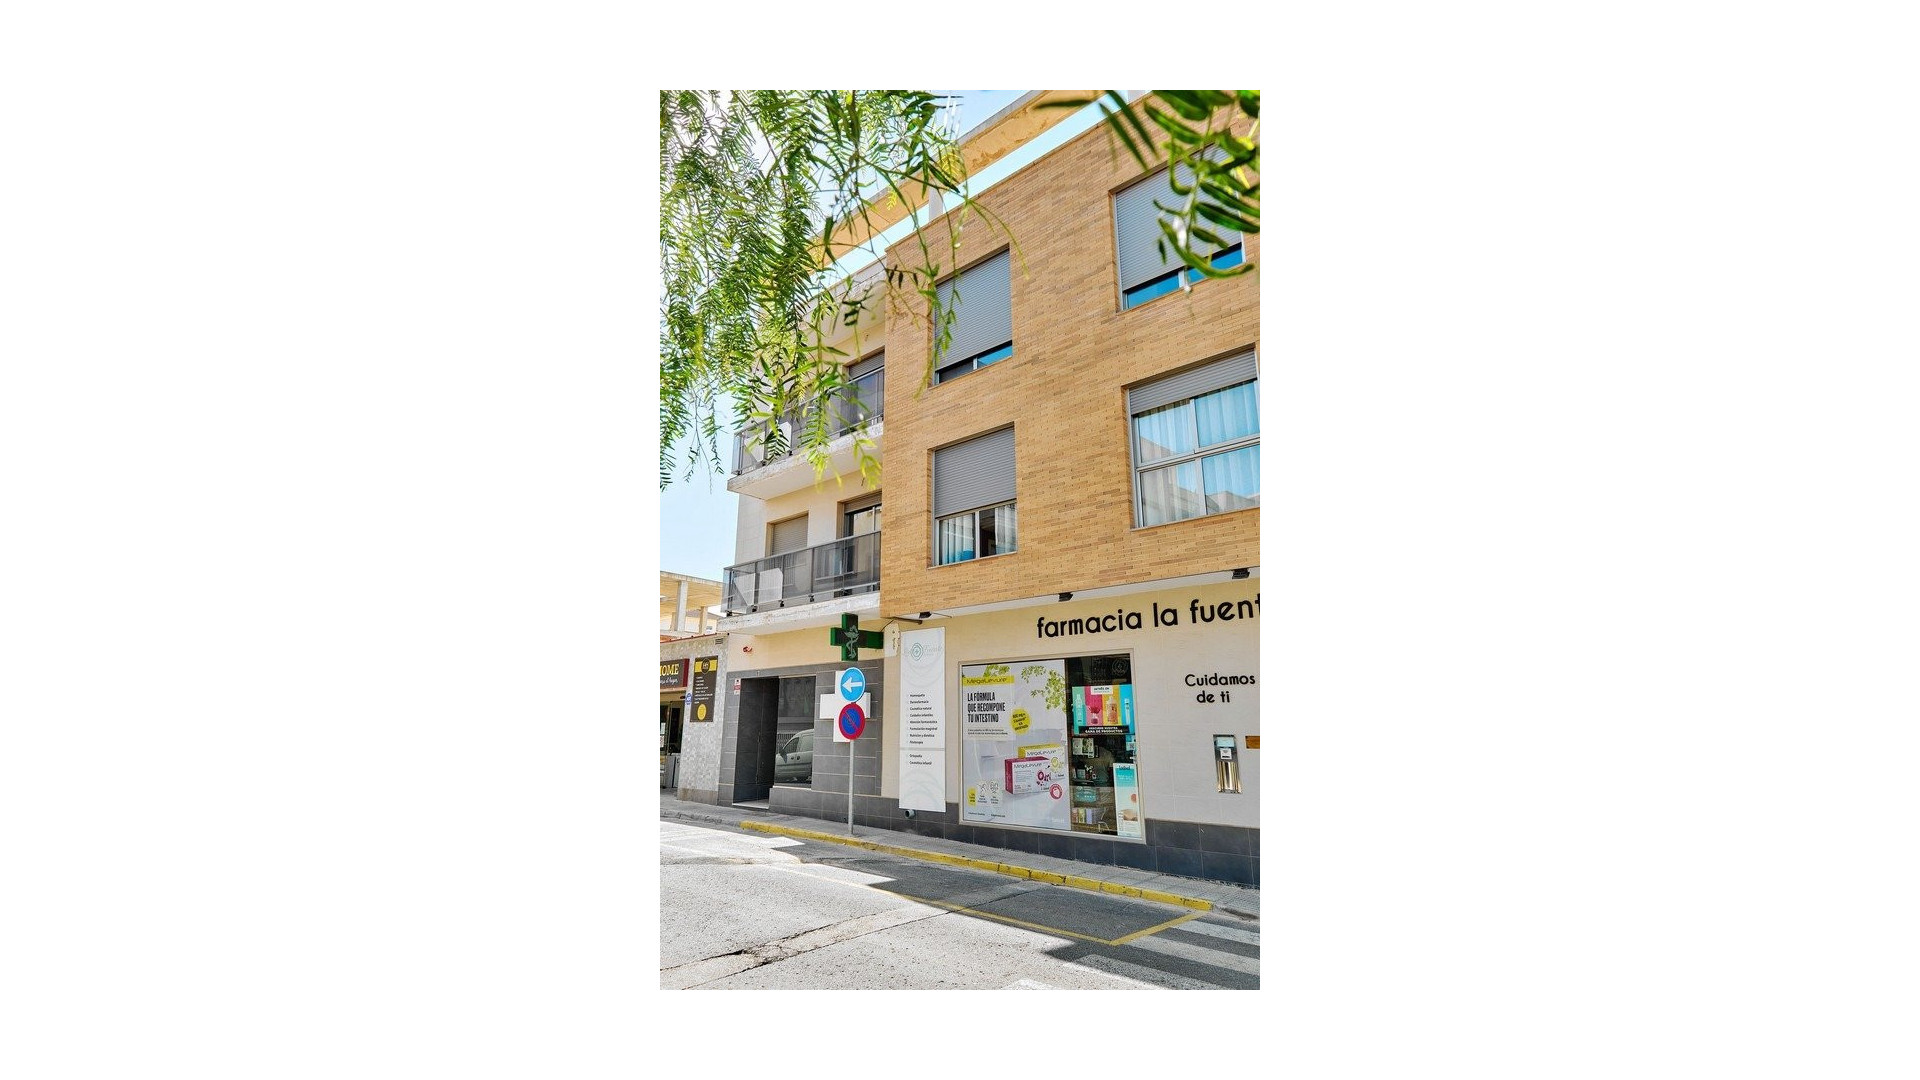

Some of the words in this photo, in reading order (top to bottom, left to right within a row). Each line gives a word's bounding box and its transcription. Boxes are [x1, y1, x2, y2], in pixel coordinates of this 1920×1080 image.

[1037, 607, 1142, 638] farmacia
[1153, 602, 1178, 627] la
[1184, 673, 1256, 687] Cuidamos
[967, 692, 974, 701] LA
[1196, 690, 1215, 703] de
[1220, 691, 1230, 703] ti
[967, 703, 976, 713] QUE
[976, 702, 1006, 712] RECOMPONE
[967, 714, 974, 723] TU
[974, 713, 999, 723] INTESTINO
